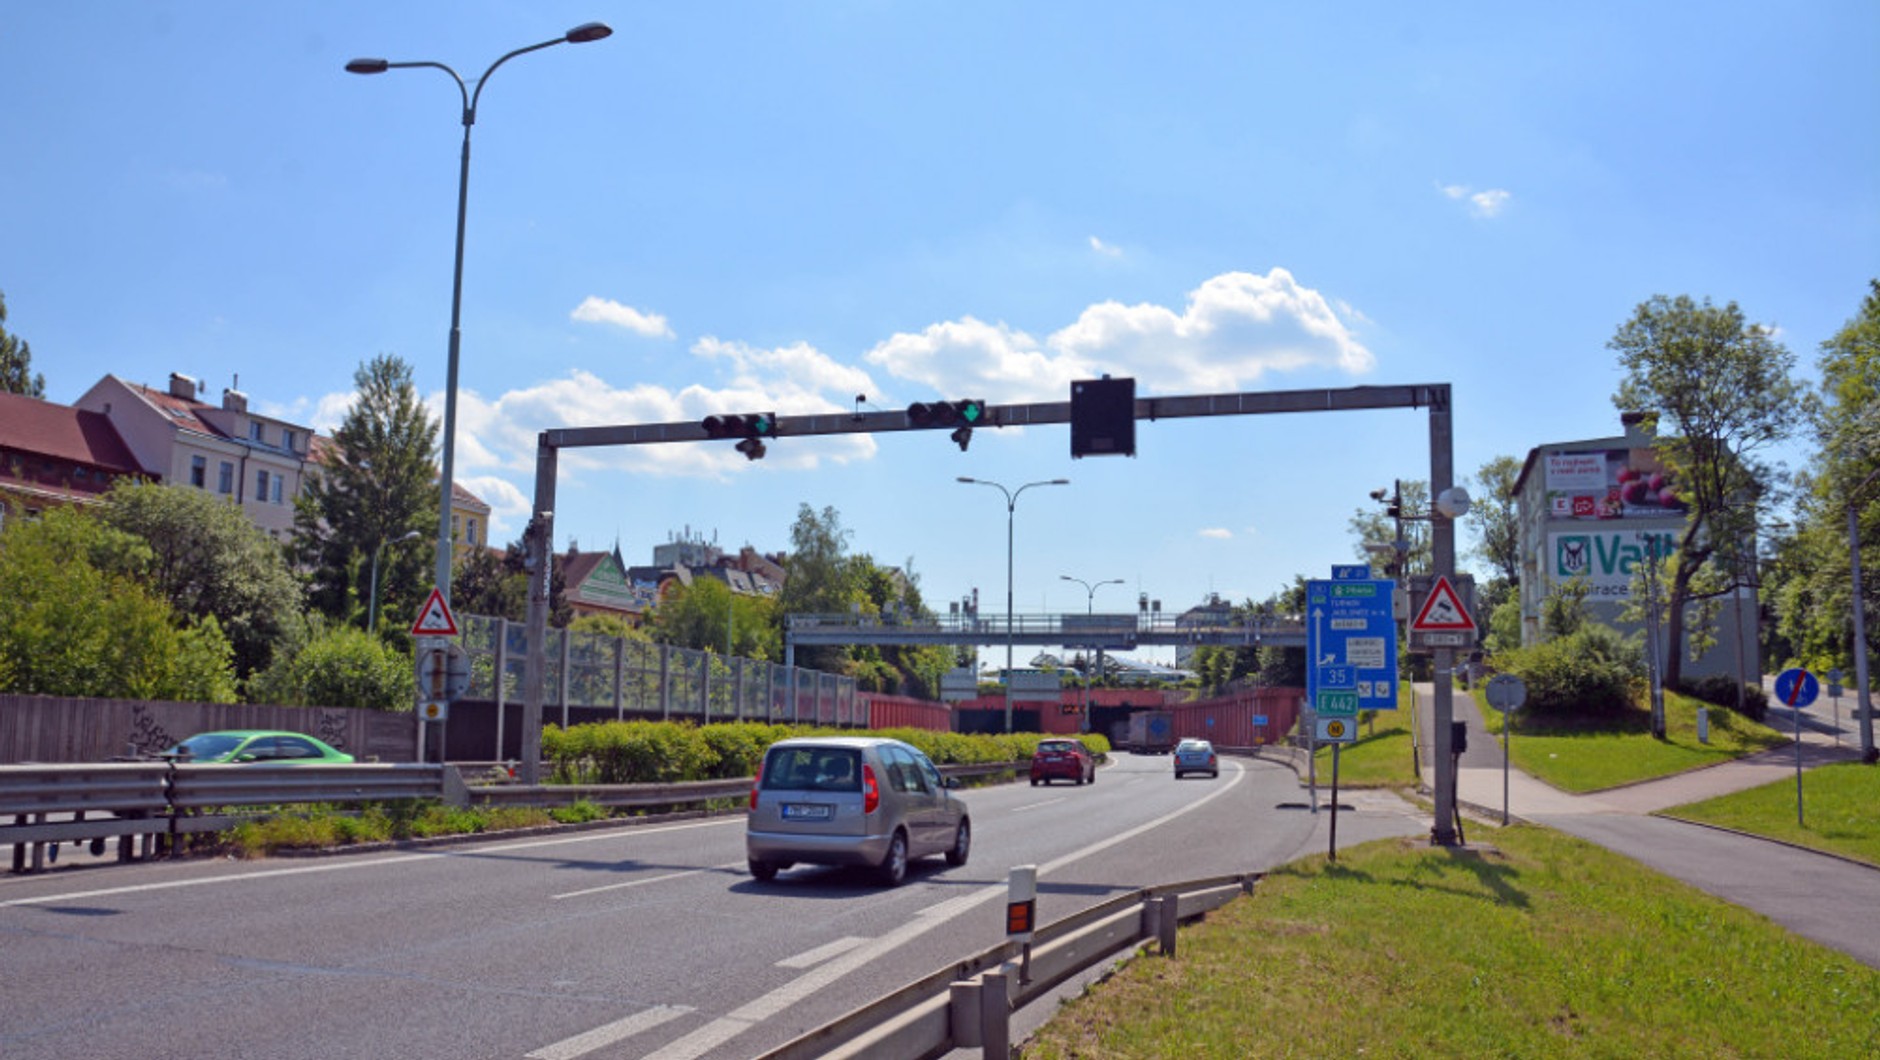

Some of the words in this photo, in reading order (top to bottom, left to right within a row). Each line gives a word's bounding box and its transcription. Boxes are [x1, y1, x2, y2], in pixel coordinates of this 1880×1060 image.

[1329, 669, 1346, 684] 35
[1321, 695, 1328, 710] E
[1331, 695, 1353, 711] 442
